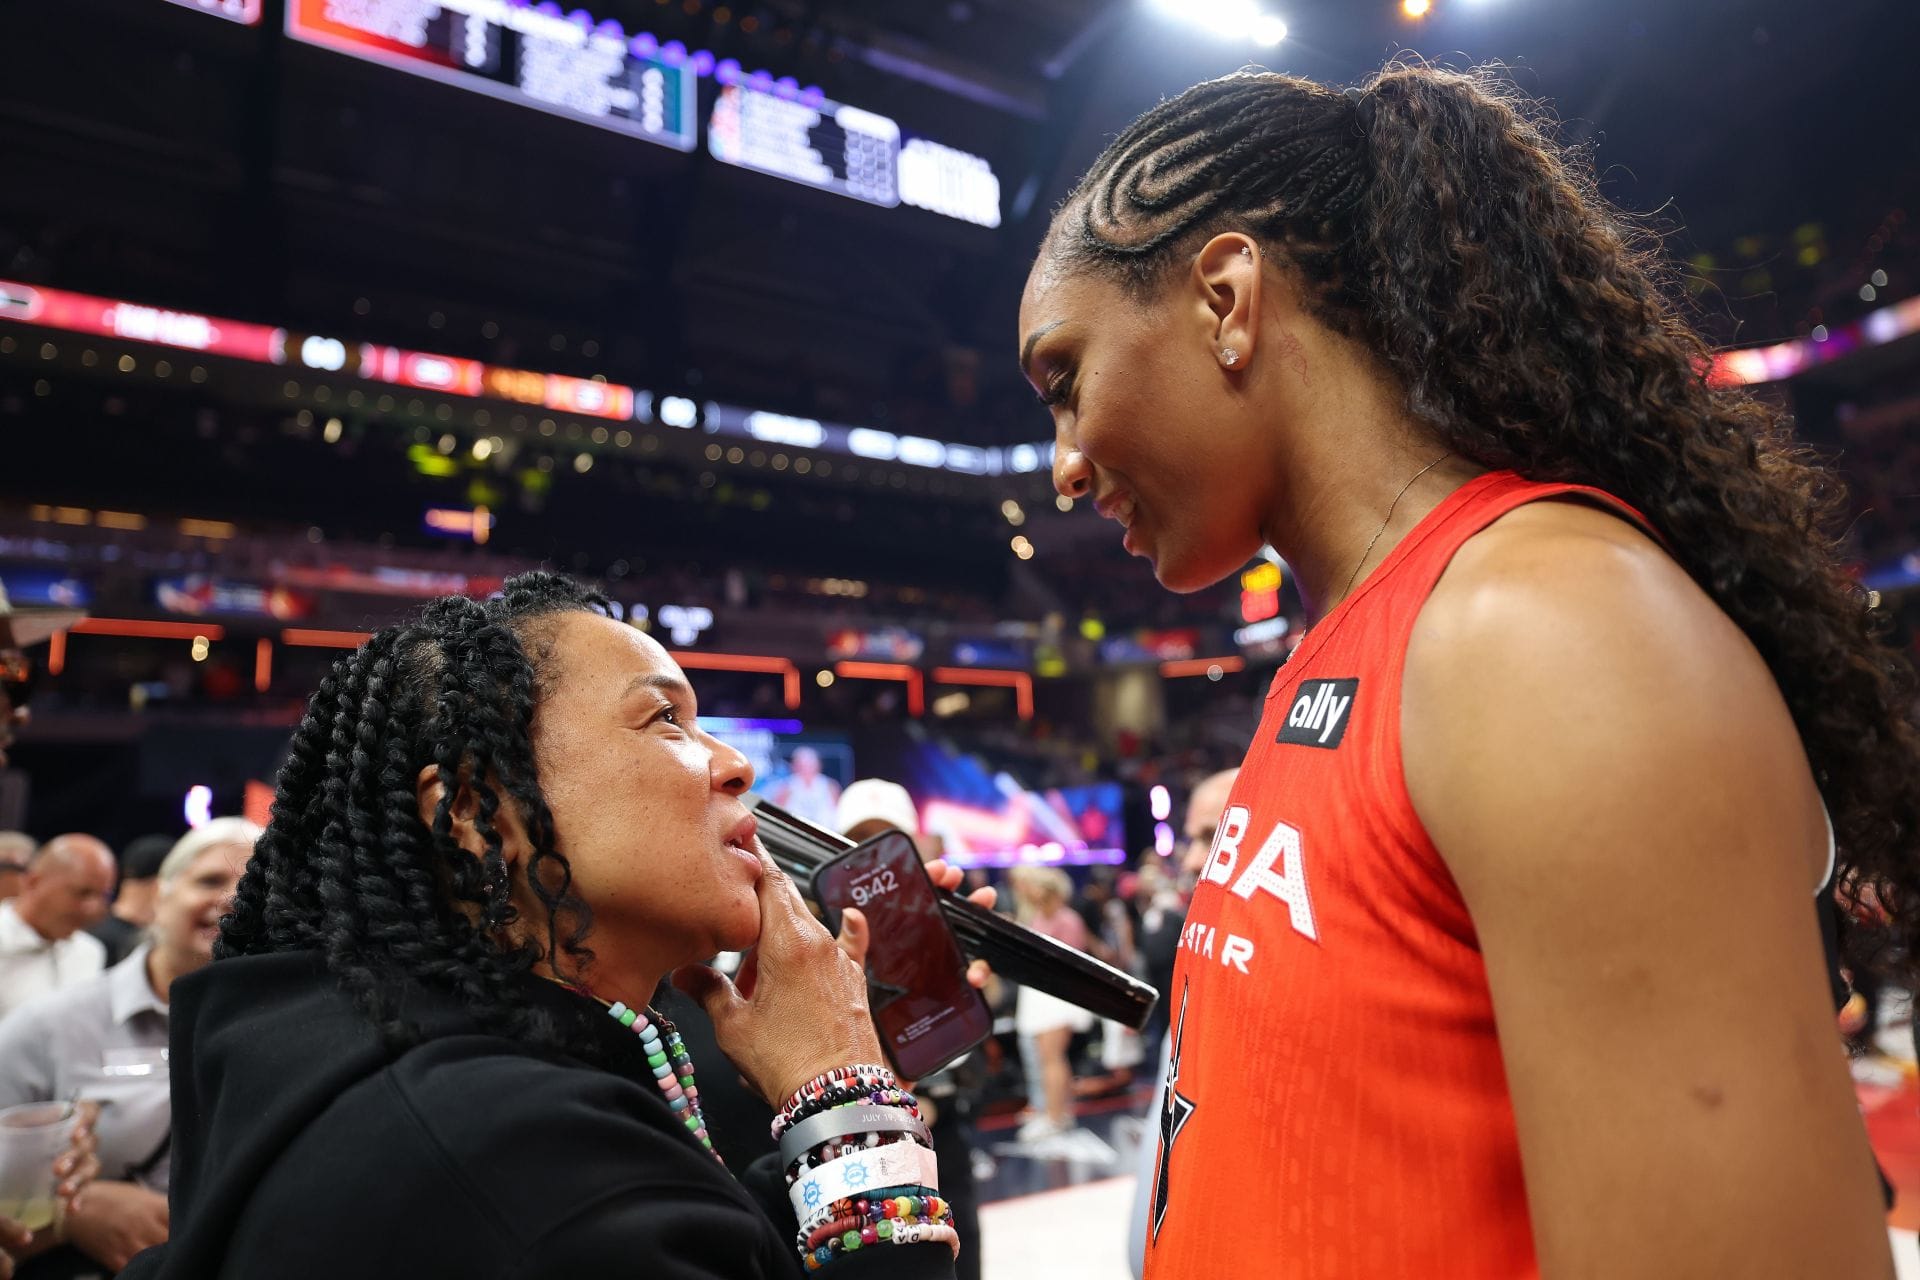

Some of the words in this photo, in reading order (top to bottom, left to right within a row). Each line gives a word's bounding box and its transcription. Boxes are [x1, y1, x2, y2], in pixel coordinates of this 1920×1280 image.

[1289, 683, 1350, 743] ally
[851, 870, 899, 906] 9:42
[862, 1113, 881, 1122] JULY
